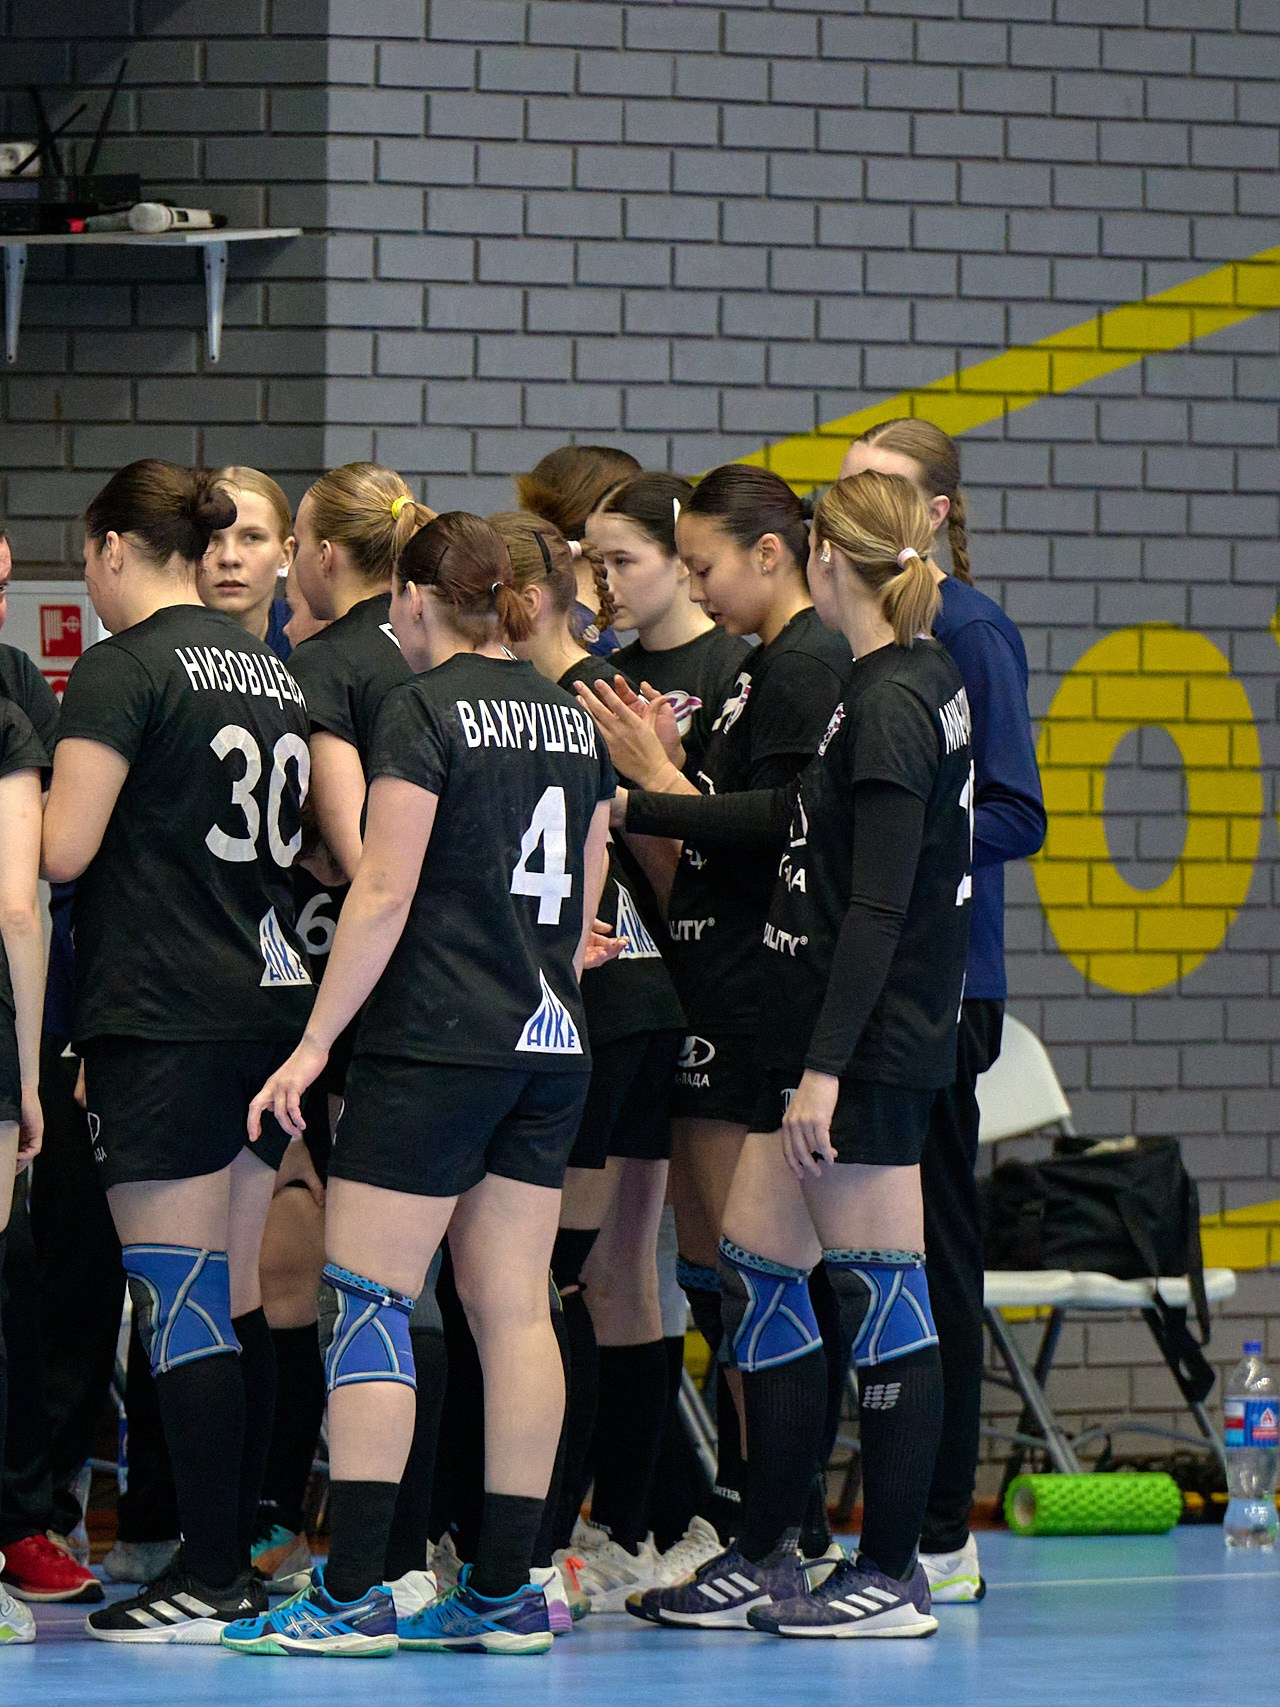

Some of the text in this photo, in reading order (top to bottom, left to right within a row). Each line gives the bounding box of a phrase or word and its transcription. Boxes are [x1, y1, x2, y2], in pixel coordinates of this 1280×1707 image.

[455, 699, 599, 761] ВАХРУШЕВА
[204, 723, 312, 869] 30
[510, 785, 573, 926] 4
[294, 893, 337, 956] 6
